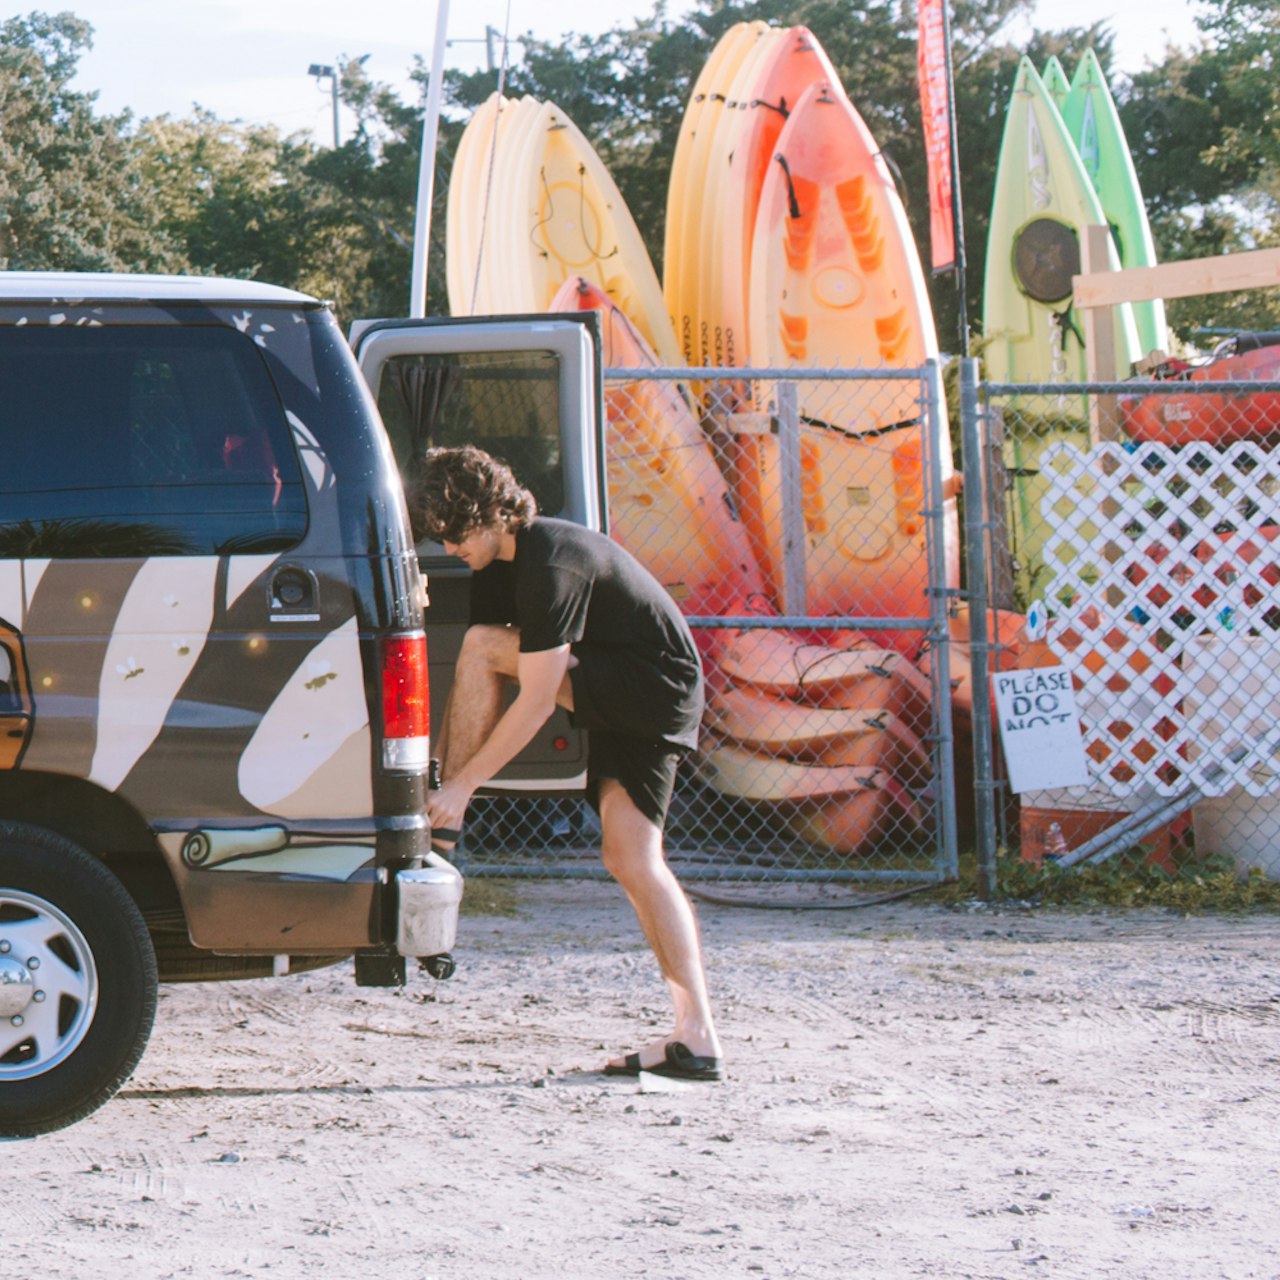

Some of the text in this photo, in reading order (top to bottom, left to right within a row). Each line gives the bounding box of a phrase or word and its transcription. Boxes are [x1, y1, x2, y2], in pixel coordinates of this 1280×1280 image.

[682, 315, 692, 362] OCEAN
[999, 671, 1071, 695] PLEASE
[1012, 693, 1059, 716] DO
